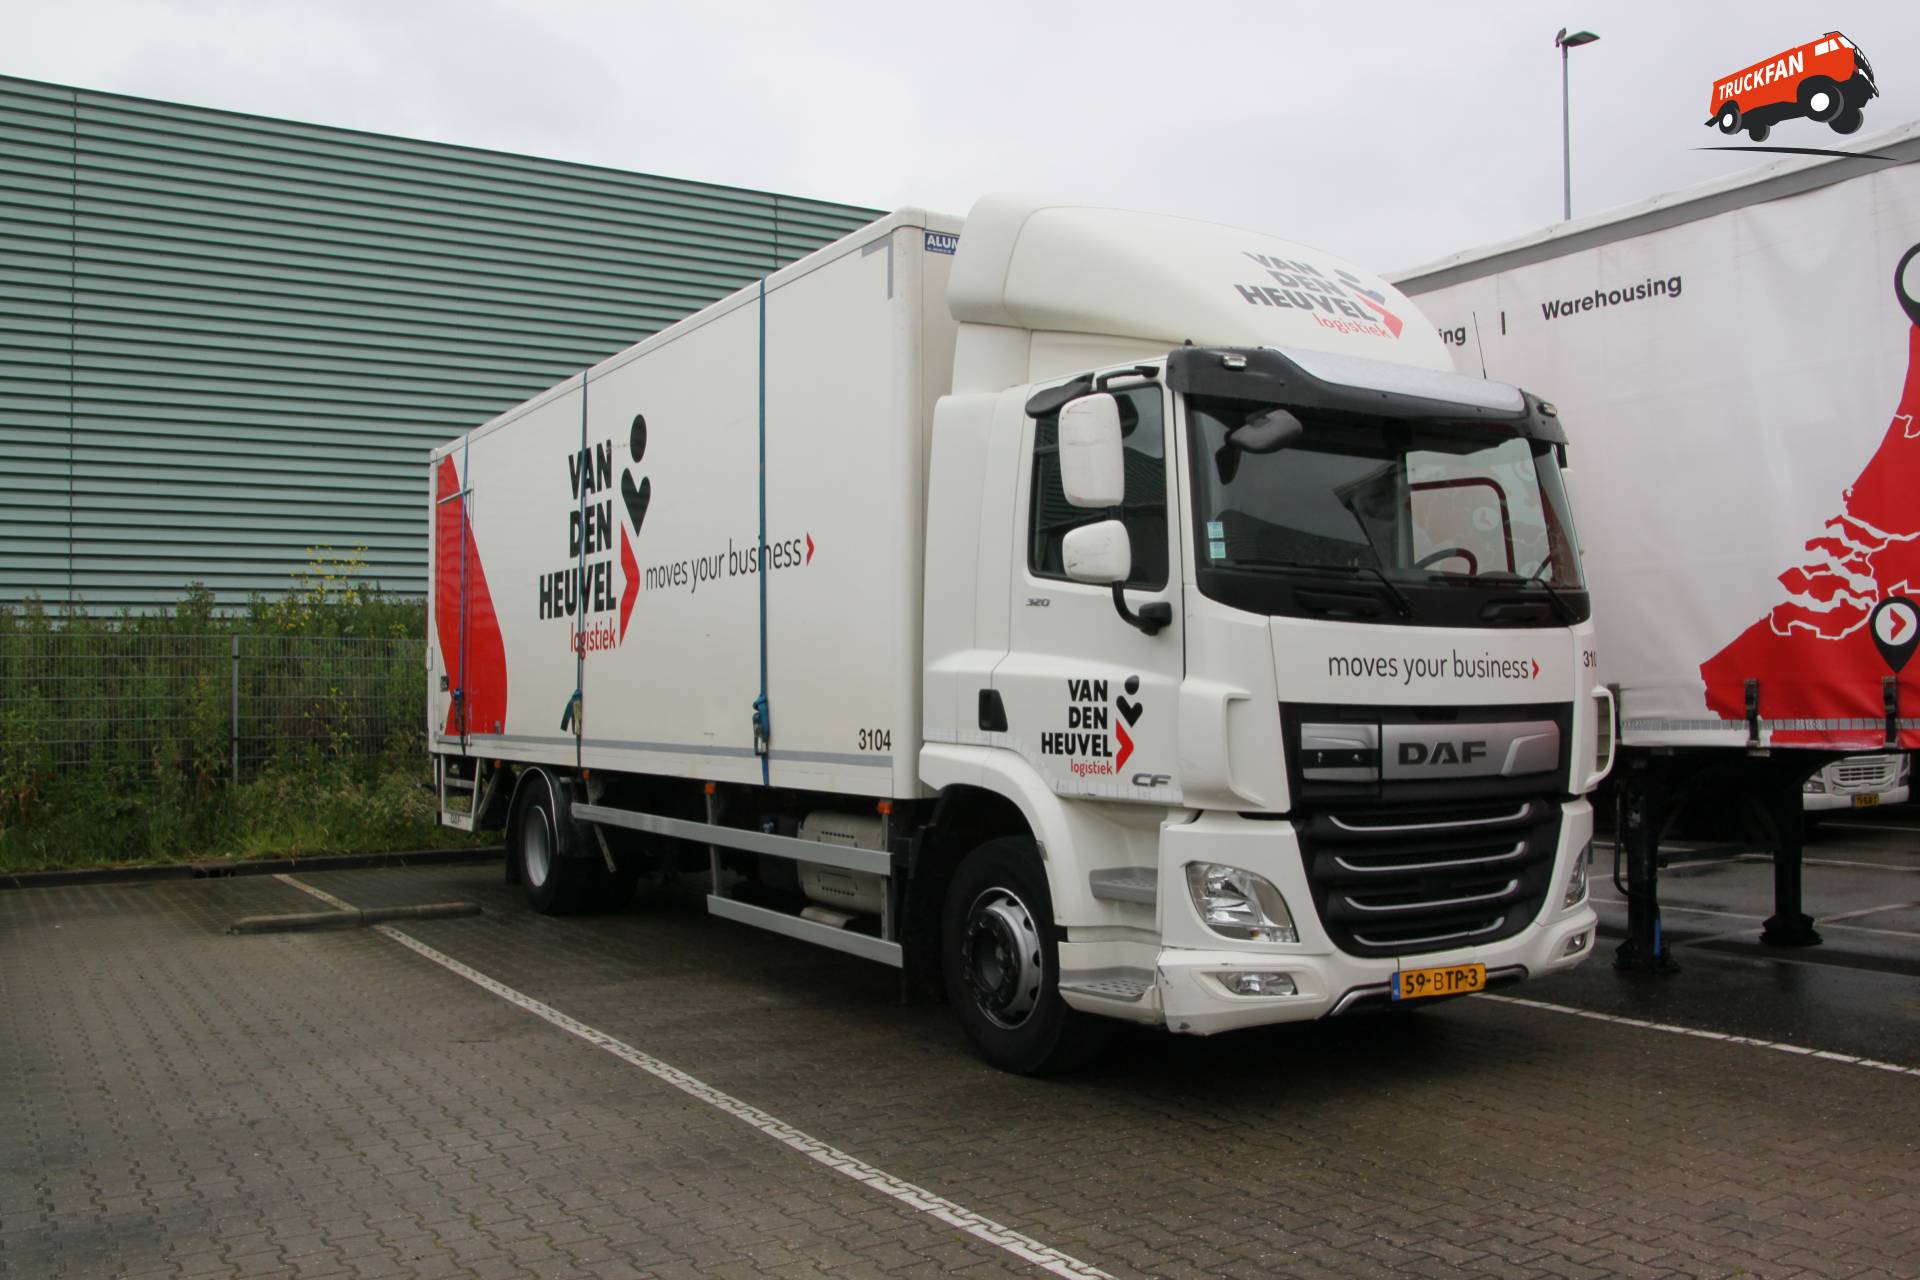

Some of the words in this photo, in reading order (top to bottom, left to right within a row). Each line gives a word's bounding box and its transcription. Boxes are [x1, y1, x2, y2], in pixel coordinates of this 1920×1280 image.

[1240, 250, 1324, 277] VAN
[1266, 270, 1347, 297] DEN
[1234, 284, 1377, 322] HEUVEL
[1540, 275, 1682, 320] Warehousing
[1312, 313, 1391, 337] logistiek
[568, 439, 612, 500] VAN
[569, 500, 612, 559] DEN
[646, 560, 688, 591] moves
[691, 552, 725, 594] your
[729, 535, 801, 577] business
[539, 560, 616, 620] HEUVEL
[1026, 598, 1050, 607] 320
[570, 617, 616, 661] logistiek
[1329, 655, 1398, 677] moves
[1404, 656, 1448, 685] your
[1452, 649, 1529, 679] business
[1068, 679, 1108, 702] VAN
[1068, 706, 1108, 729] DEN
[858, 728, 892, 751] 3104
[1041, 732, 1113, 757] HEUVEL
[1398, 741, 1487, 766] DAF
[1070, 758, 1113, 777] logistiek
[1132, 773, 1172, 787] CF
[1405, 968, 1479, 994] 59-BTP-3
